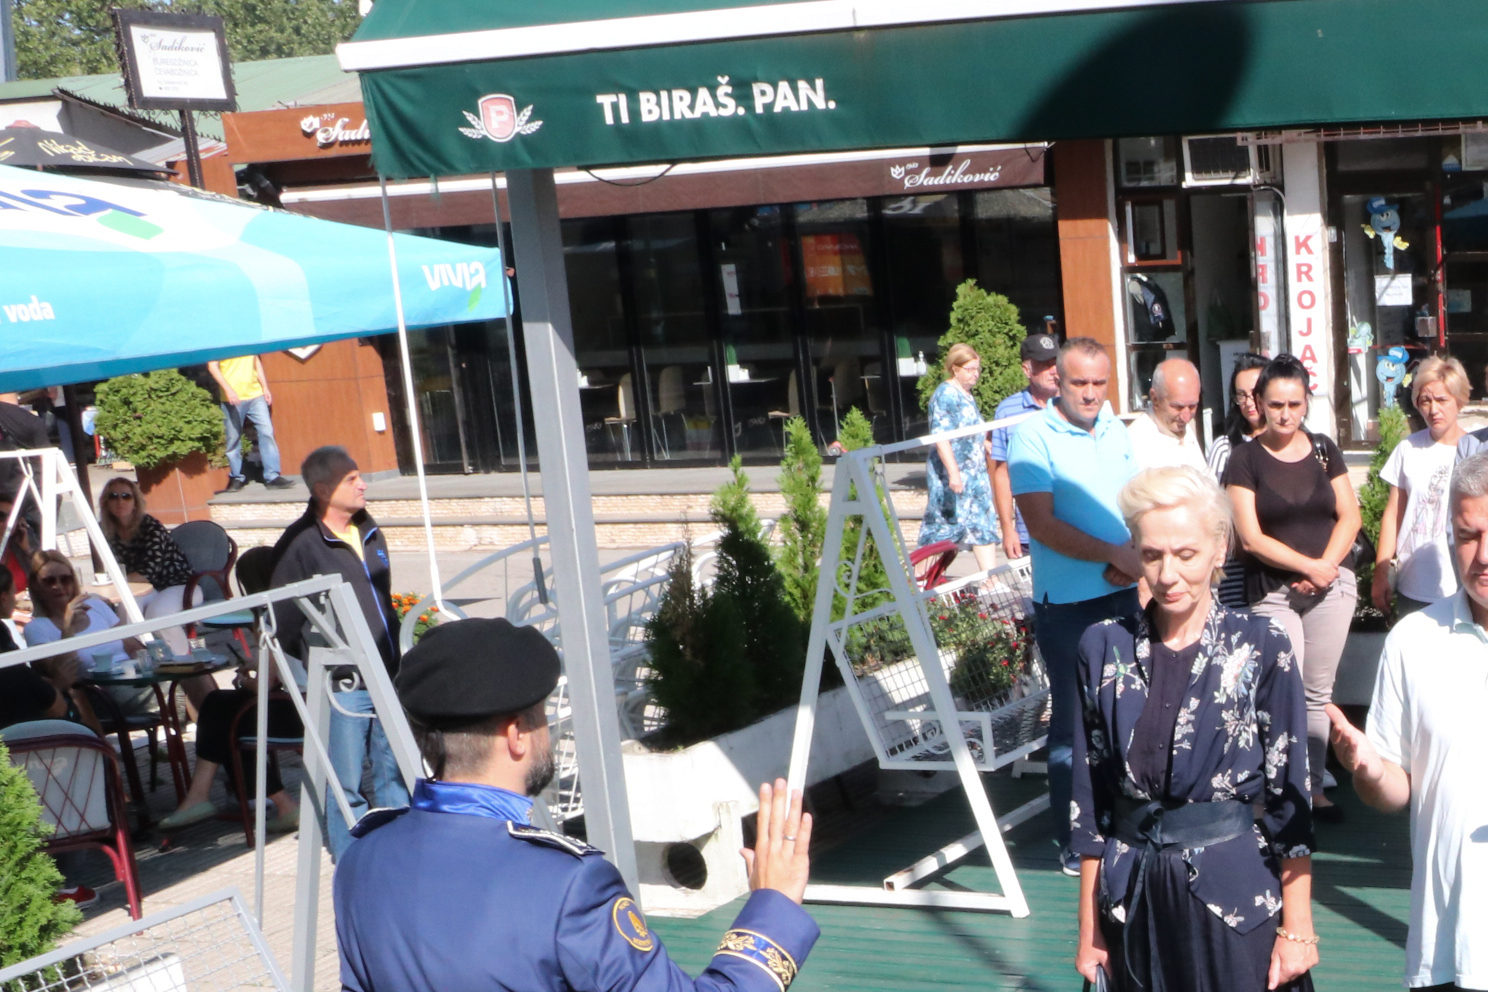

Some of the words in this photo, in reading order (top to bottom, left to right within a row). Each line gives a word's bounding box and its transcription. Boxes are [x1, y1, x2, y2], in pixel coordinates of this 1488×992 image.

[596, 93, 630, 125] TI
[639, 75, 746, 123] BIRAŠ.
[752, 78, 837, 114] PAN.
[904, 159, 1002, 190] Sadiković
[2, 294, 56, 323] voda
